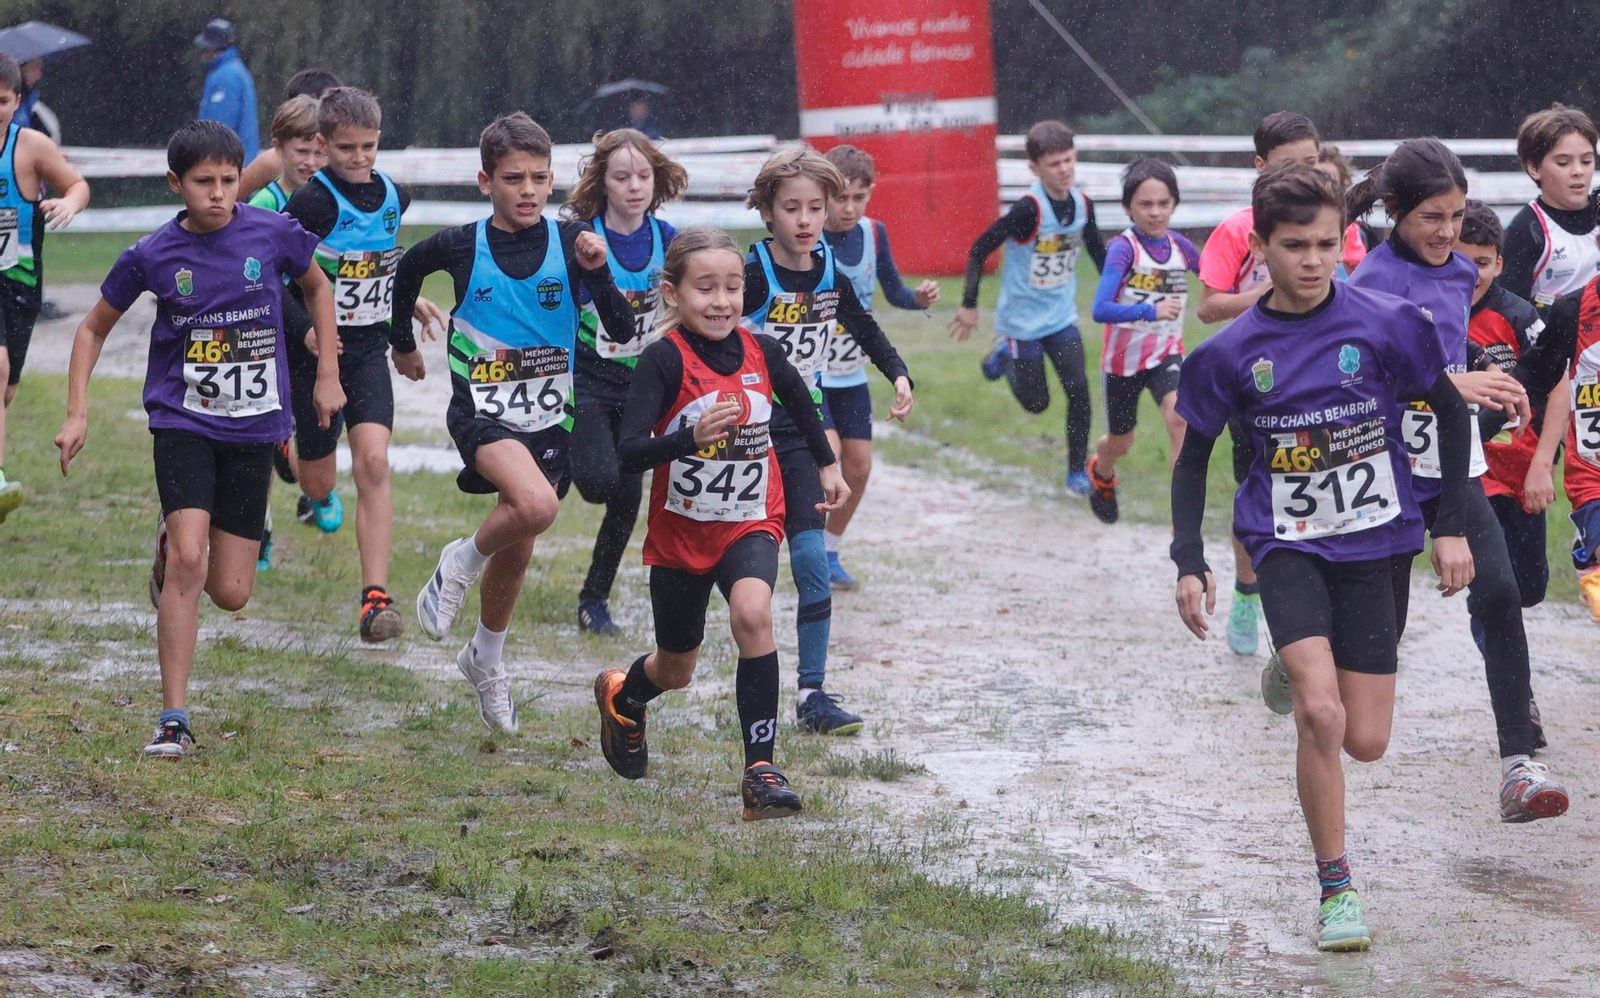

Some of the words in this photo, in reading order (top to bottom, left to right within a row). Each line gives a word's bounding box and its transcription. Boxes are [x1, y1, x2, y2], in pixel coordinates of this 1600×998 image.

[187, 312, 223, 325] CHANS
[226, 305, 270, 322] BEMBRIVE
[238, 337, 275, 348] BELARMINO
[250, 346, 275, 357] ALONSO
[521, 355, 569, 368] BELARMINO
[534, 362, 567, 374] ALONSO
[195, 362, 267, 400] 313
[476, 378, 563, 418] 346
[1254, 415, 1277, 428] CEIP
[1280, 411, 1322, 428] CHANS
[1324, 397, 1377, 422] BEMBRIVE
[1329, 427, 1385, 452] BELARMINO
[1347, 438, 1385, 458] ALONSO
[672, 456, 763, 501] 342
[1283, 461, 1381, 518] 312
